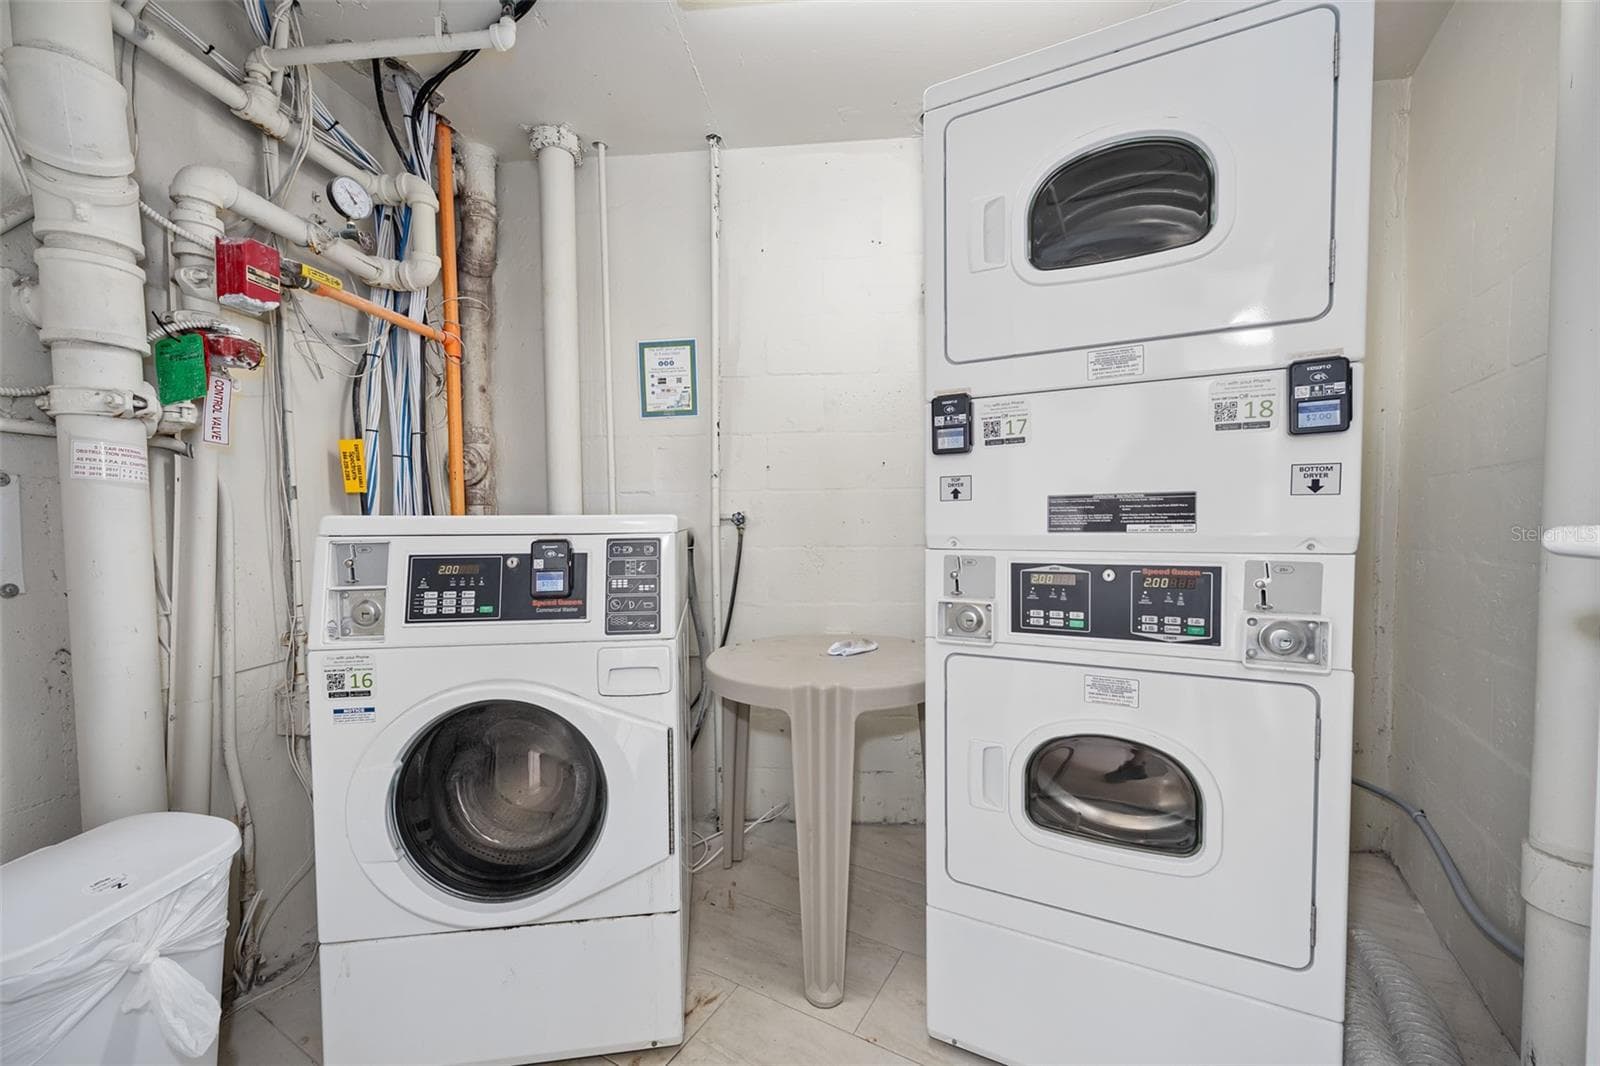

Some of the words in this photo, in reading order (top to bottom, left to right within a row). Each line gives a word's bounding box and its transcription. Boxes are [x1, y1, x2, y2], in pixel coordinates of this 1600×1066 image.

[212, 379, 224, 413] CONTROL
[1244, 400, 1274, 419] 18
[211, 417, 222, 441] VALVE
[1005, 419, 1027, 436] 17
[1031, 574, 1053, 585] 2.00
[1142, 568, 1170, 577] Speed
[1171, 569, 1201, 577] Queen
[1143, 577, 1169, 588] 2.00
[350, 673, 373, 689] 16
